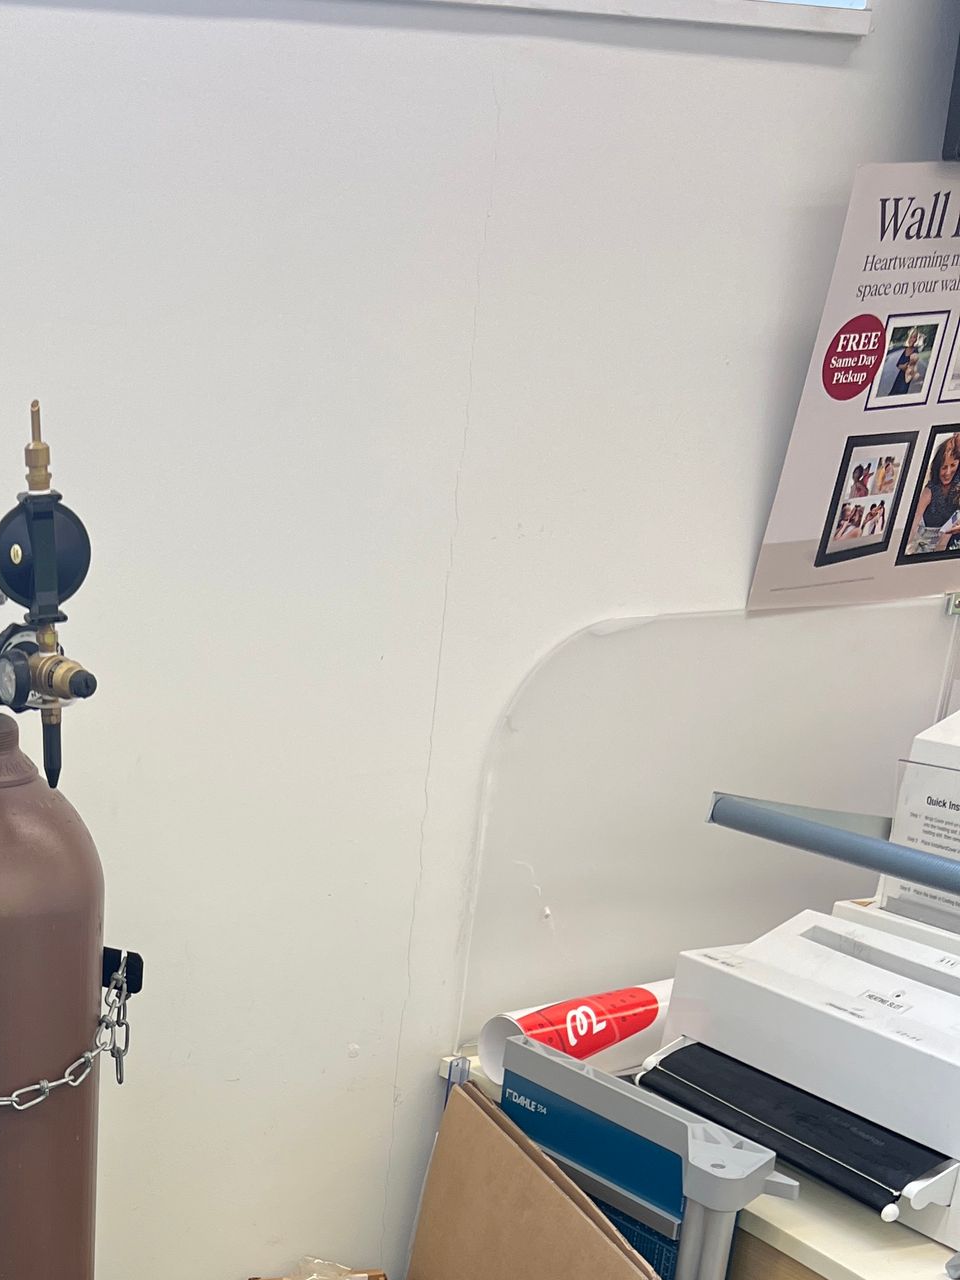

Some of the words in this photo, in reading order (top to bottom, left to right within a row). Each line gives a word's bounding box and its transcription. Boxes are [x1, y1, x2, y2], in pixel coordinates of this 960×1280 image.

[879, 190, 952, 242] Wall
[862, 250, 951, 272] Heartwarming
[856, 282, 892, 302] space
[893, 281, 909, 296] on
[909, 279, 939, 299] your
[836, 331, 881, 353] FREE
[829, 356, 858, 369] Same
[858, 354, 878, 368] Day
[832, 370, 867, 385] Pickup
[926, 795, 947, 809] Quick
